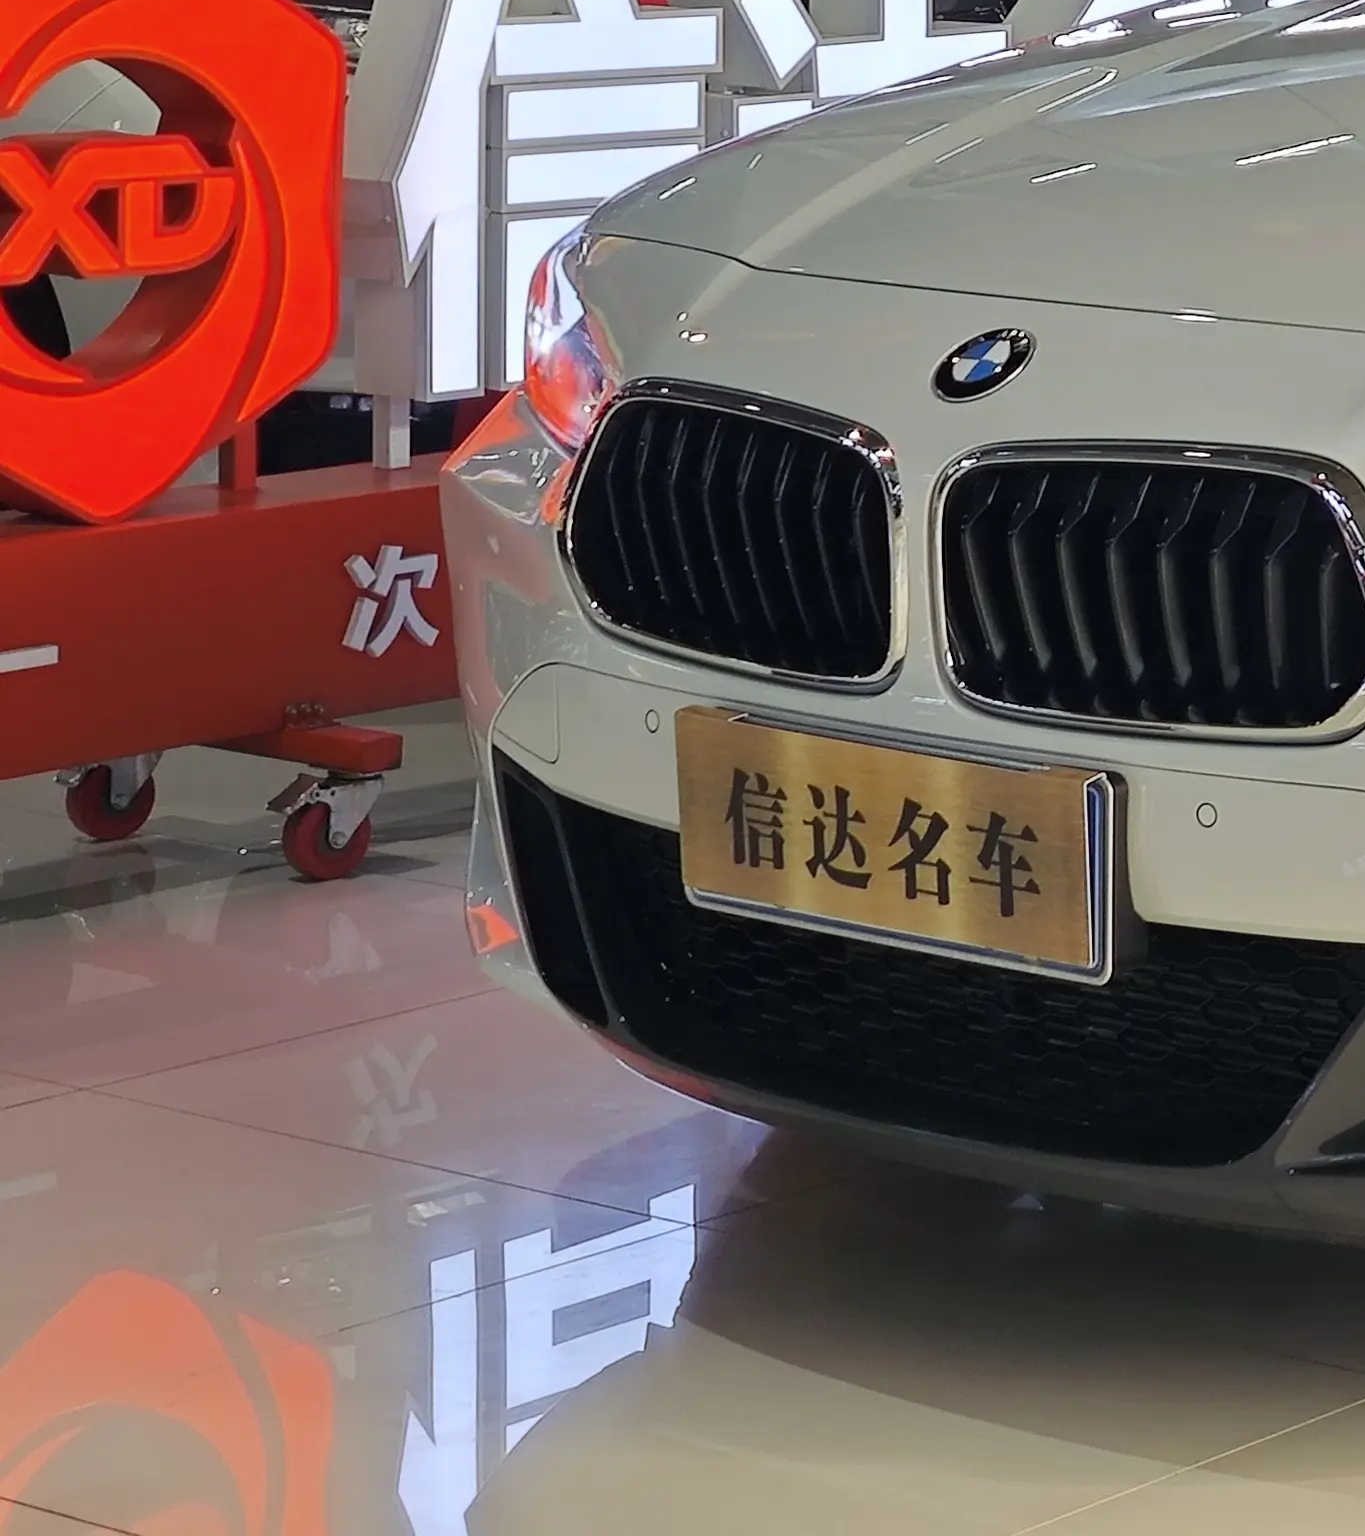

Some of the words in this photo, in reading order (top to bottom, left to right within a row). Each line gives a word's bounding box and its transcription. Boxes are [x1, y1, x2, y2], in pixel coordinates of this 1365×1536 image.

[343, 543, 440, 657] 次
[723, 766, 1042, 918] 信达名车
